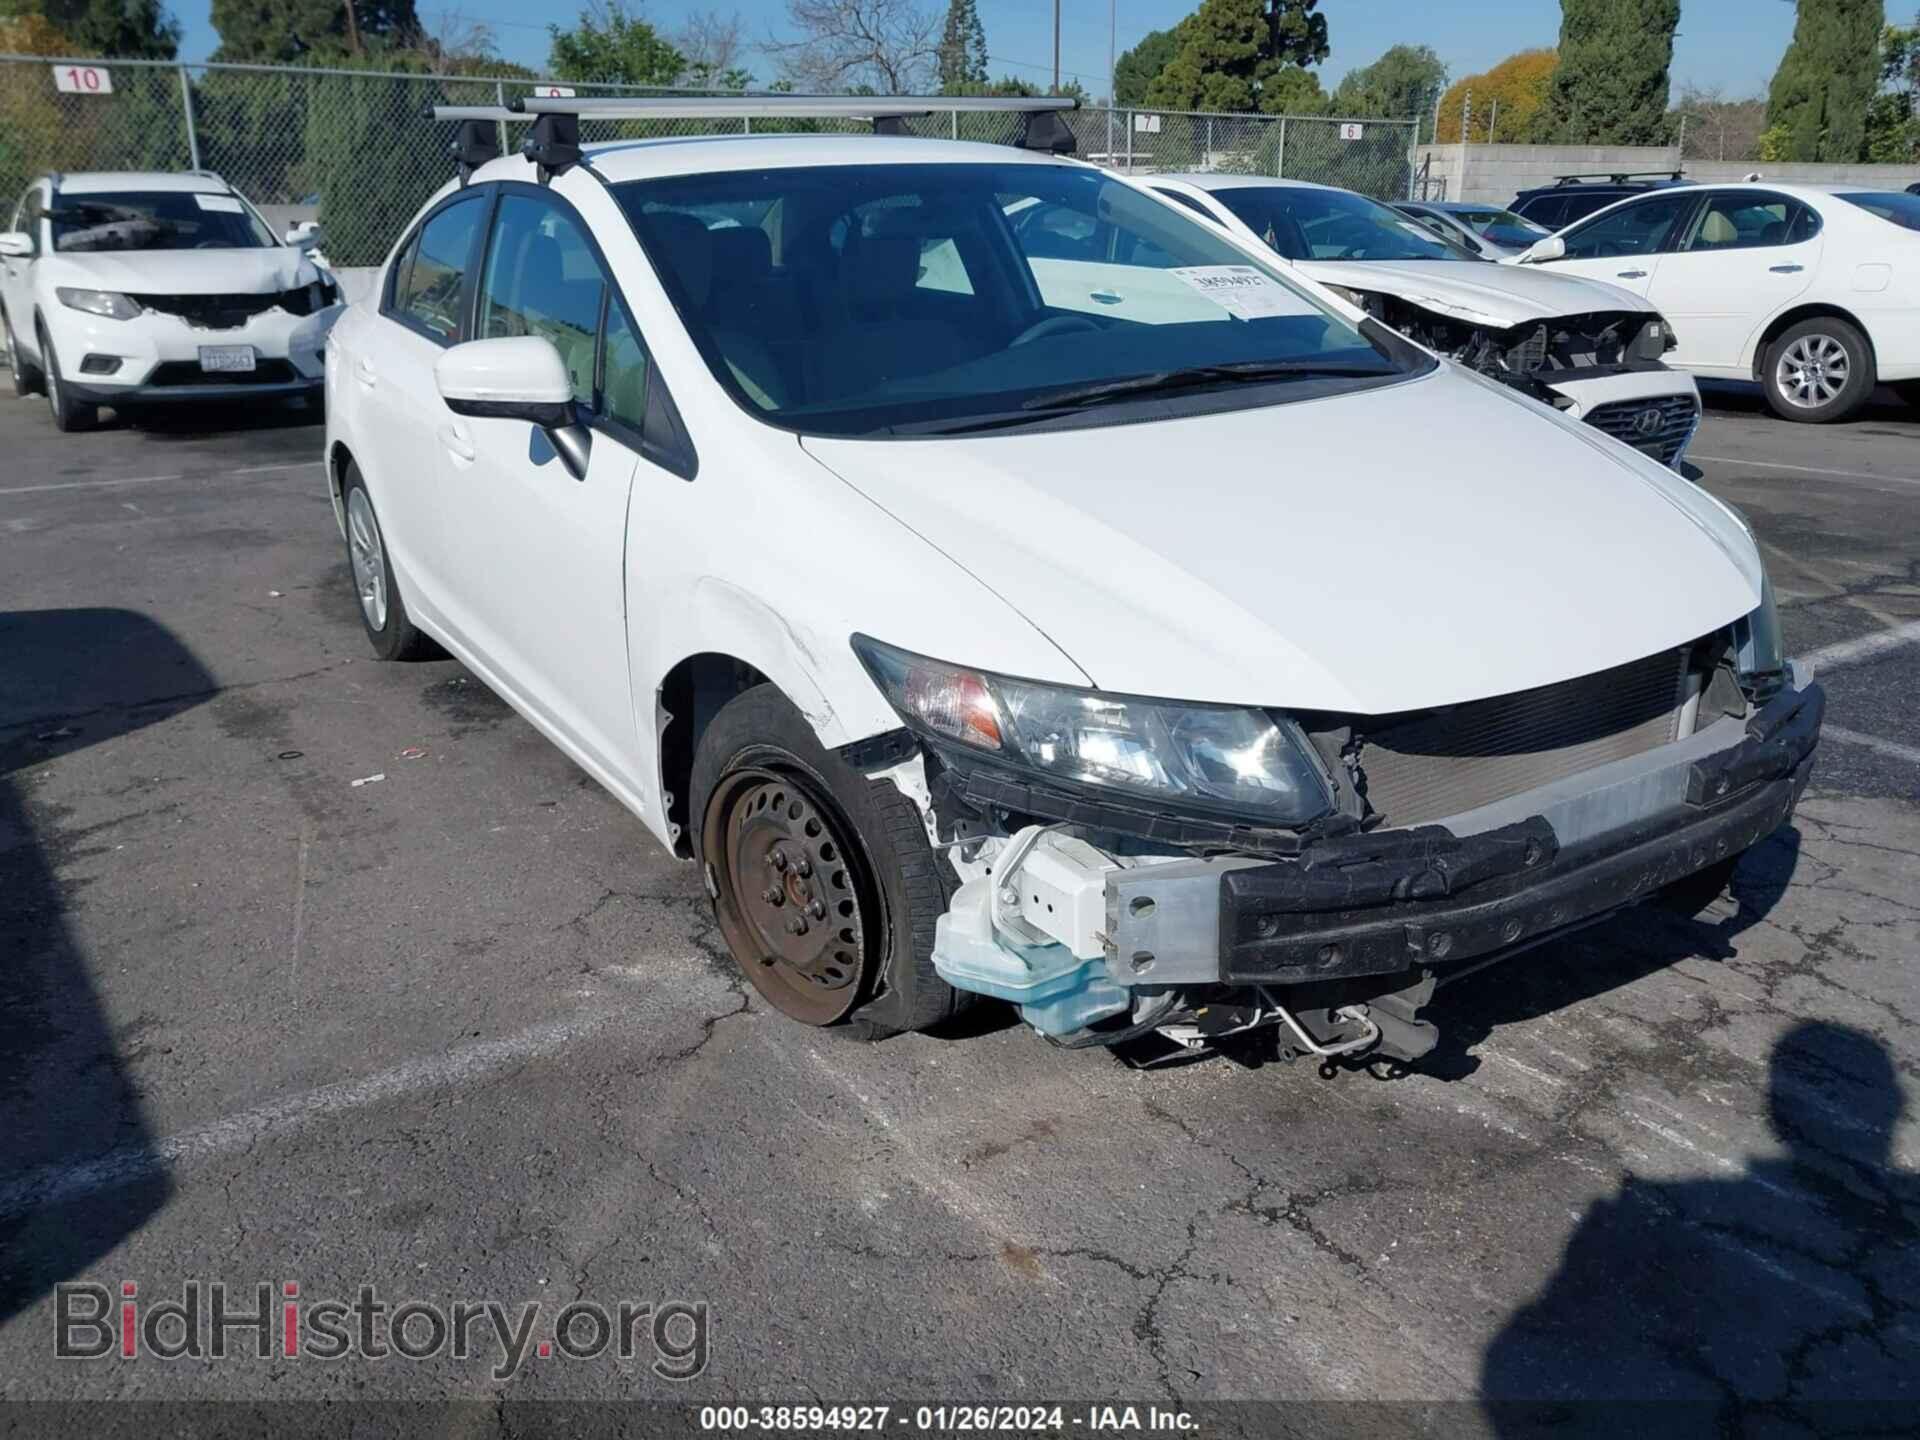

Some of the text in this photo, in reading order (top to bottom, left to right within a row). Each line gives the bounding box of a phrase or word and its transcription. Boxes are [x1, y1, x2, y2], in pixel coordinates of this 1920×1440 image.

[67, 68, 99, 90] 10
[1143, 115, 1152, 130] 7
[1347, 125, 1355, 138] 6
